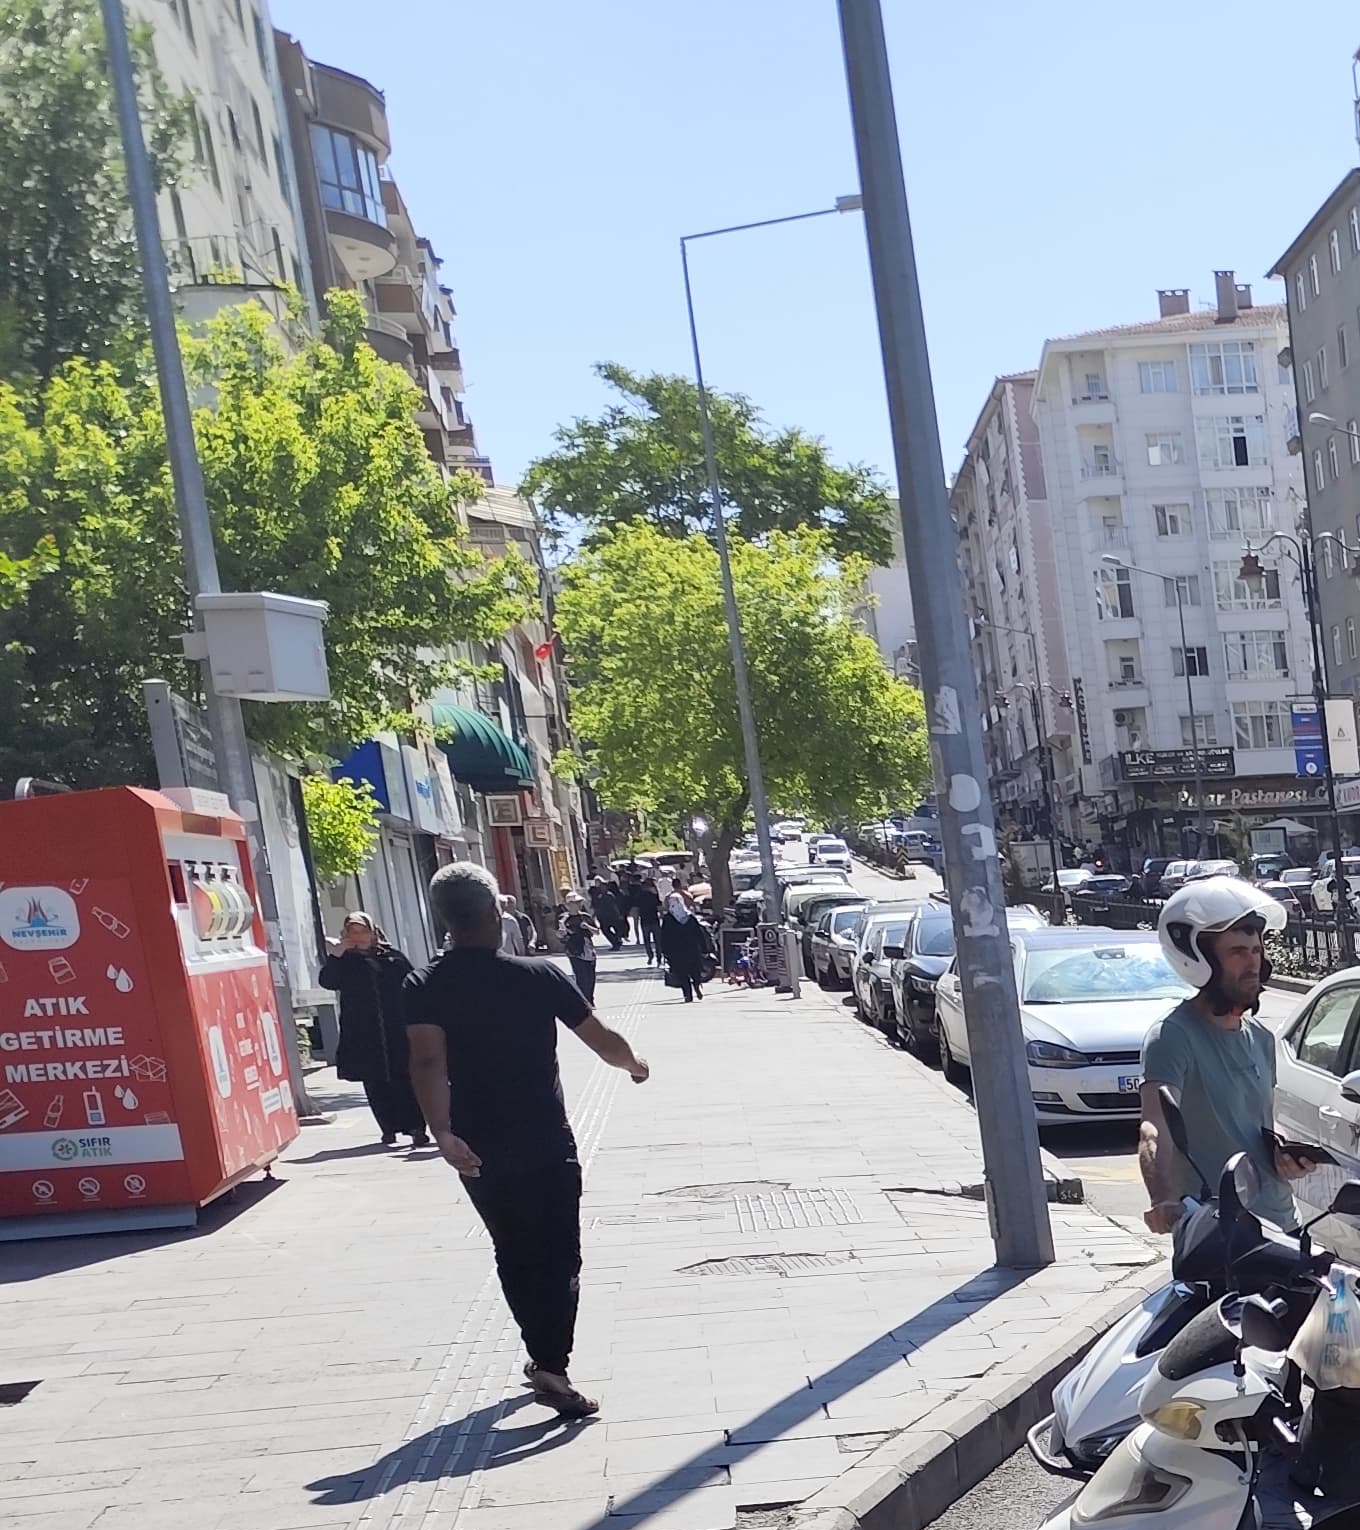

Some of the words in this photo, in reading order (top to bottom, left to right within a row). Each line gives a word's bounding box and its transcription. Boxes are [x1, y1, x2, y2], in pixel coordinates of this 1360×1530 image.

[12, 928, 68, 939] NEVŞEHİR
[24, 996, 90, 1018] ATIK
[0, 1025, 125, 1051] GETİRME
[5, 1054, 131, 1083] MERKEZİ
[79, 1136, 112, 1149] SIFIR
[81, 1146, 113, 1159] ATIK
